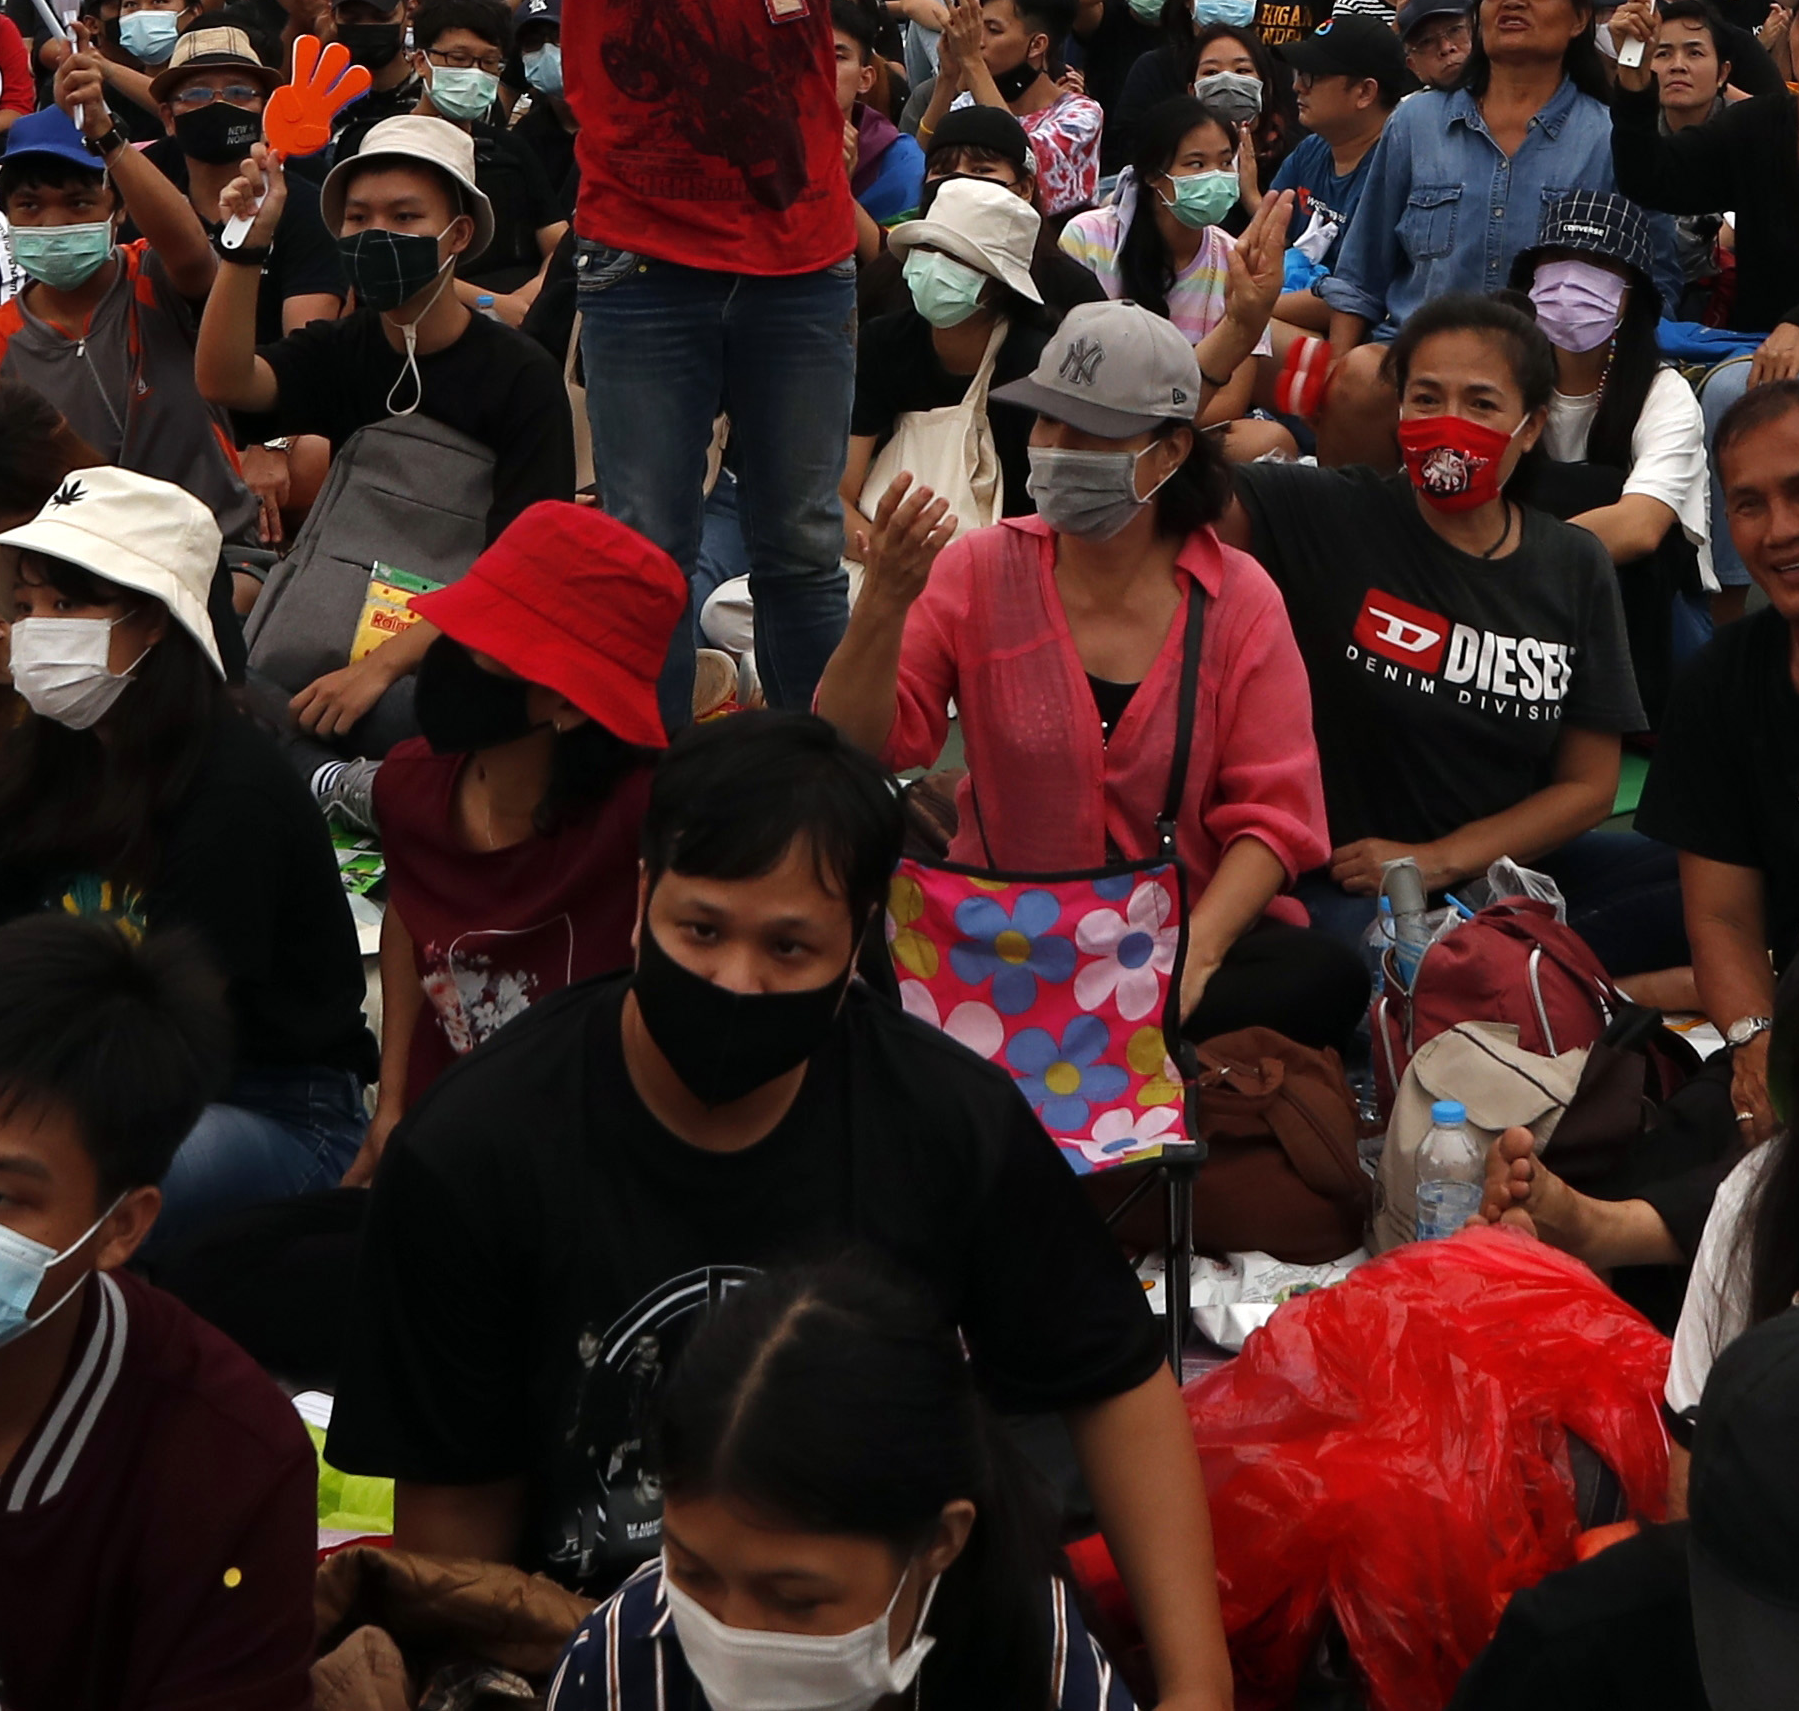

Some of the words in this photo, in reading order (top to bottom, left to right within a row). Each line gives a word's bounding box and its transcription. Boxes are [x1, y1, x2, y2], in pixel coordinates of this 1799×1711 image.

[1562, 224, 1605, 237] CONVERSE
[1346, 645, 1436, 695] DENIM
[1458, 690, 1562, 721] DIVISIO
[1443, 622, 1573, 702] DIESEL
